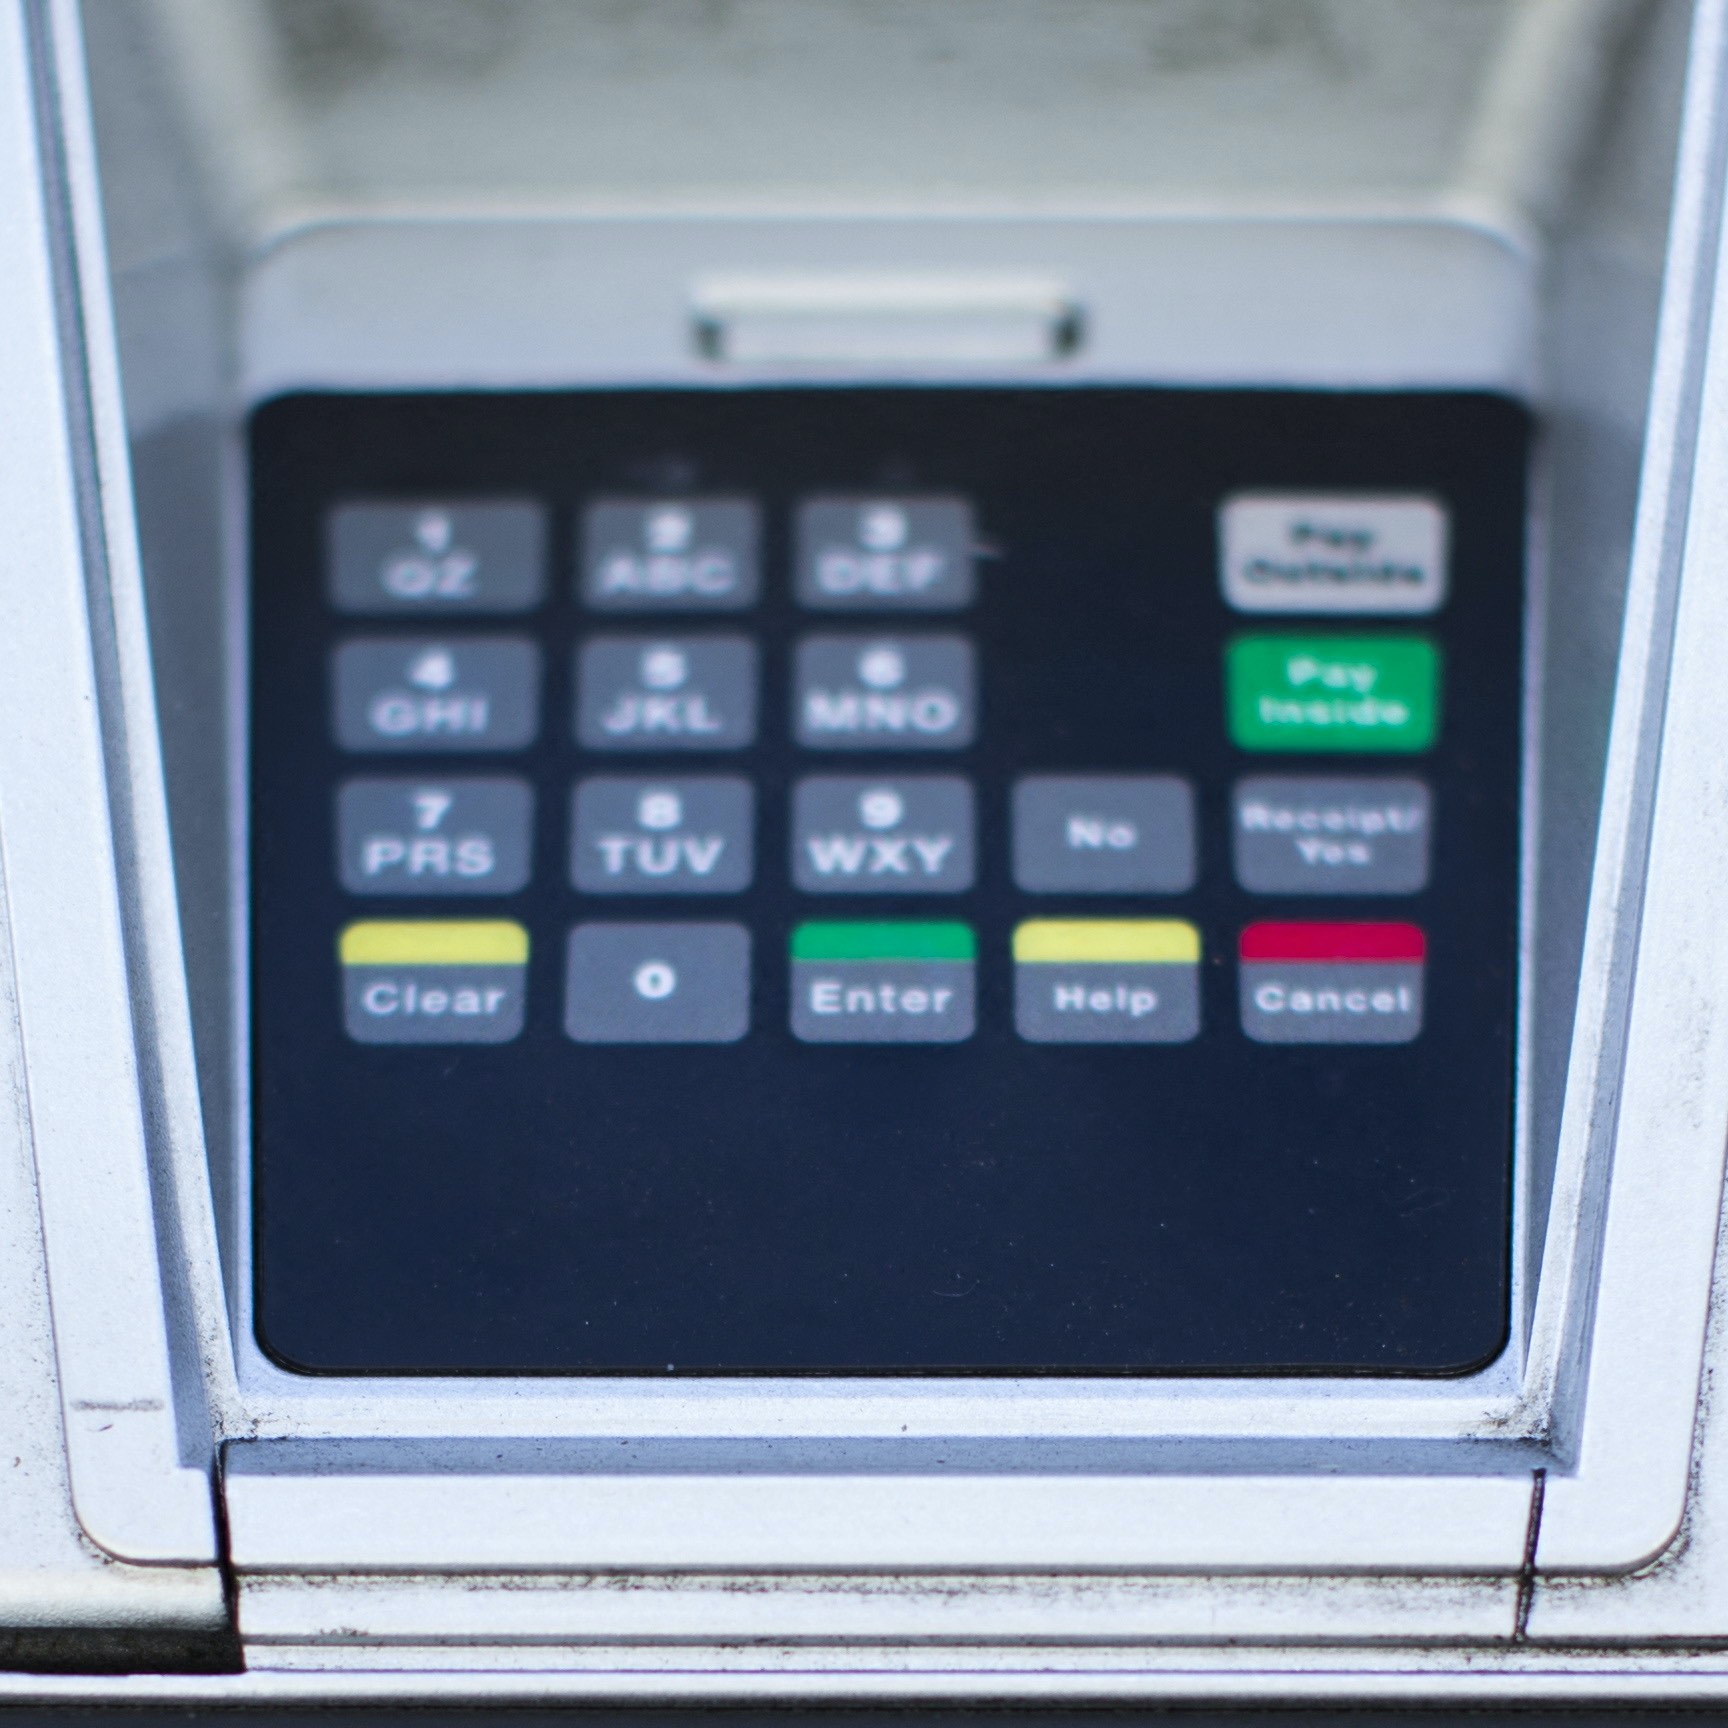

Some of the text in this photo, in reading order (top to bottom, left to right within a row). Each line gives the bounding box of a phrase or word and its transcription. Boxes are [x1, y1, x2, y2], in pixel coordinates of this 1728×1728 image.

[1291, 523, 1374, 552] Pay
[604, 554, 730, 592] ABC
[820, 553, 941, 591] DEF
[1245, 559, 1425, 586] Outside
[415, 654, 451, 687] 4
[646, 652, 683, 686] 5
[862, 651, 900, 686] 6
[1288, 658, 1375, 693] Pay
[373, 697, 486, 733] GHI
[606, 696, 718, 732] JKL
[808, 695, 955, 730] MNO
[1260, 697, 1408, 725] Inside
[417, 793, 449, 828] 7
[641, 794, 679, 827] 8
[862, 793, 901, 827] 9
[1242, 802, 1419, 834] Receipt/
[1068, 818, 1135, 847] No
[365, 839, 493, 875] PRS
[600, 837, 722, 874] TUV
[810, 838, 950, 872] WXY
[1297, 838, 1369, 864] Yes
[635, 963, 675, 998] 0
[811, 981, 951, 1013] Enter
[364, 984, 504, 1014] Clear
[1054, 986, 1157, 1016] Help
[1255, 984, 1410, 1012] Cancel
